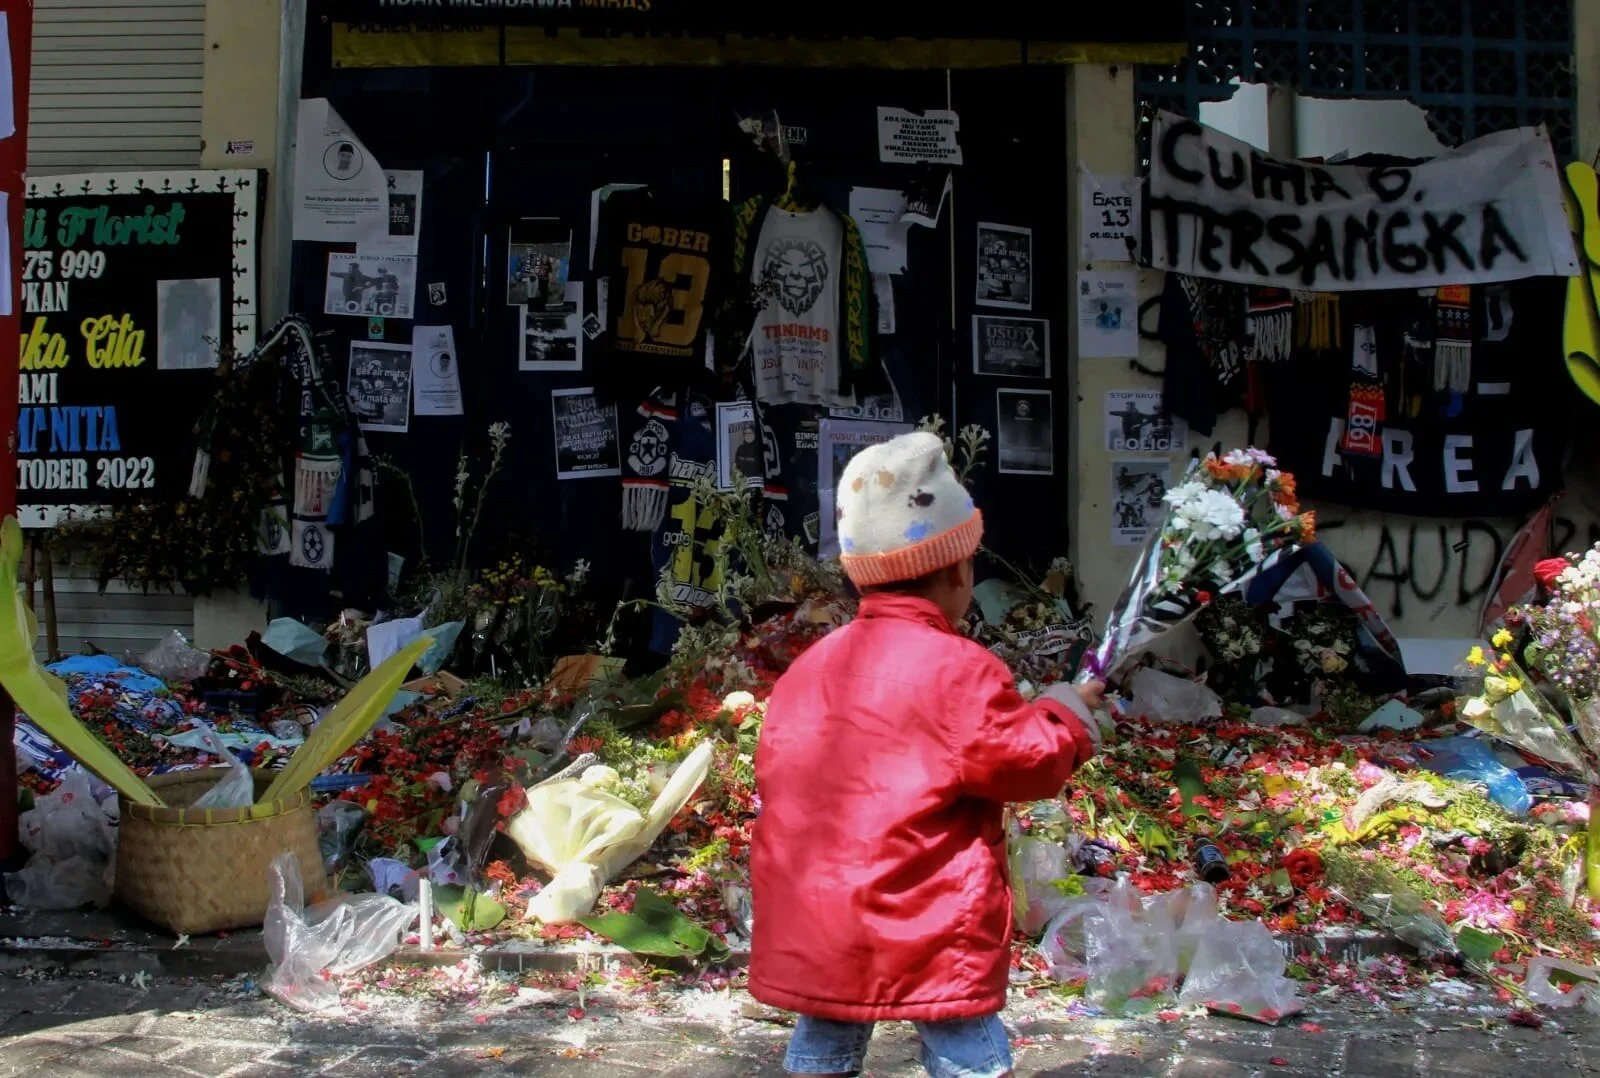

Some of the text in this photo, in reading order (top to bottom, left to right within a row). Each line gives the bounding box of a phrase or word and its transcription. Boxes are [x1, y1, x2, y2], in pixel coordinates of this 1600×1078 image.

[1161, 120, 1352, 207] CUMA
[1092, 191, 1132, 207] GATE
[1102, 209, 1130, 227] 13
[57, 201, 186, 248] Florist
[1142, 196, 1530, 286] TERSANGKA
[22, 249, 107, 280] 75 999
[616, 246, 712, 346] 13
[80, 313, 146, 369] Cita
[1113, 437, 1182, 451] POLICE
[1347, 401, 1377, 451] 1987
[16, 456, 155, 490] TOBER 2022
[662, 530, 691, 547] gate
